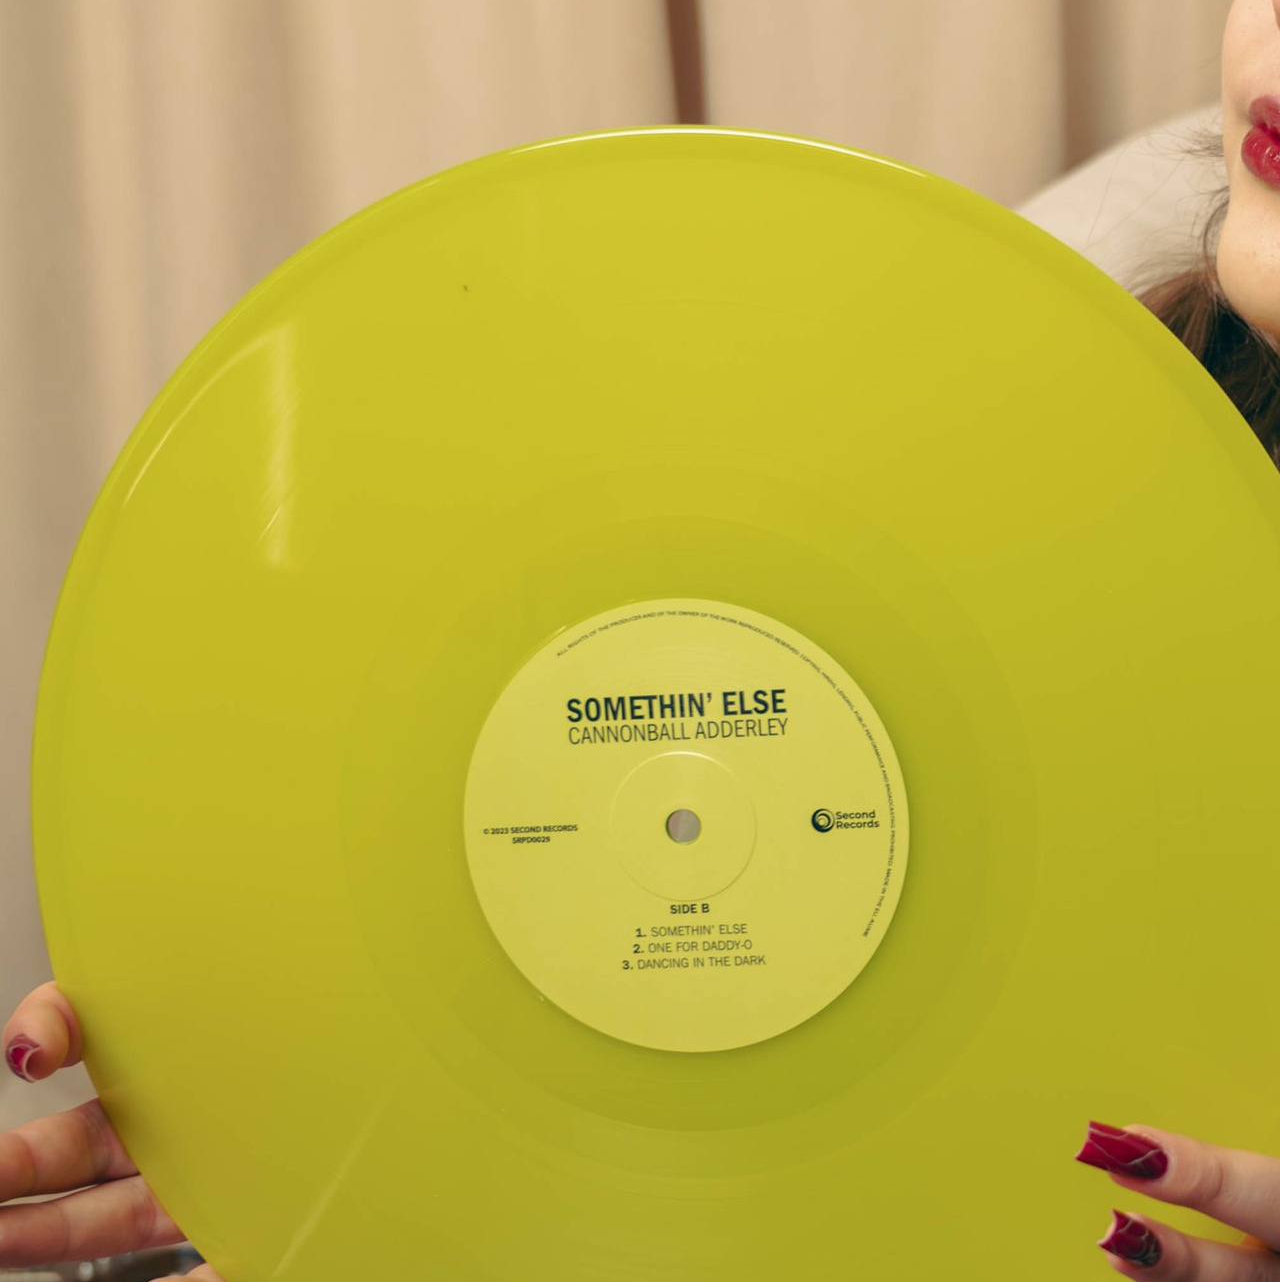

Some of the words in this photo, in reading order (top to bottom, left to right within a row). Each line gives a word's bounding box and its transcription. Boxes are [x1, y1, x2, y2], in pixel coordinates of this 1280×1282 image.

[609, 615, 641, 627] PRODUCER
[721, 616, 737, 624] WORK
[597, 624, 609, 632] THE
[738, 621, 774, 639] REPRODUCED
[556, 647, 567, 657] ALL
[567, 692, 712, 722] SOMETHIN'
[722, 689, 787, 716] ELSE
[853, 710, 867, 728] PUBLIC
[568, 722, 690, 744] CANNONBALL
[695, 718, 788, 740] ADDERLEY
[864, 728, 884, 768] PERFORMANCE
[881, 769, 889, 782] AND
[884, 783, 894, 829] BROADCASTING
[835, 810, 876, 819] Second
[490, 827, 509, 835] 2023
[510, 826, 542, 834] SECOND
[543, 824, 578, 833] RECORDS
[836, 820, 880, 829] Records
[883, 868, 891, 886] MADE
[876, 894, 884, 907] THE
[670, 904, 698, 914] SIDE
[701, 903, 710, 913] B
[635, 928, 646, 938] 1.
[650, 925, 715, 937] SOMETHIN'
[718, 923, 747, 935] ELSE
[633, 944, 644, 954] 2.
[648, 942, 673, 953] ONE
[676, 941, 698, 952] FOR
[702, 939, 752, 951] DADDY-O
[622, 960, 633, 970] 3.
[637, 958, 689, 970] DANCING
[693, 958, 704, 967] IN
[708, 956, 731, 967] THE
[734, 955, 766, 966] DARK
